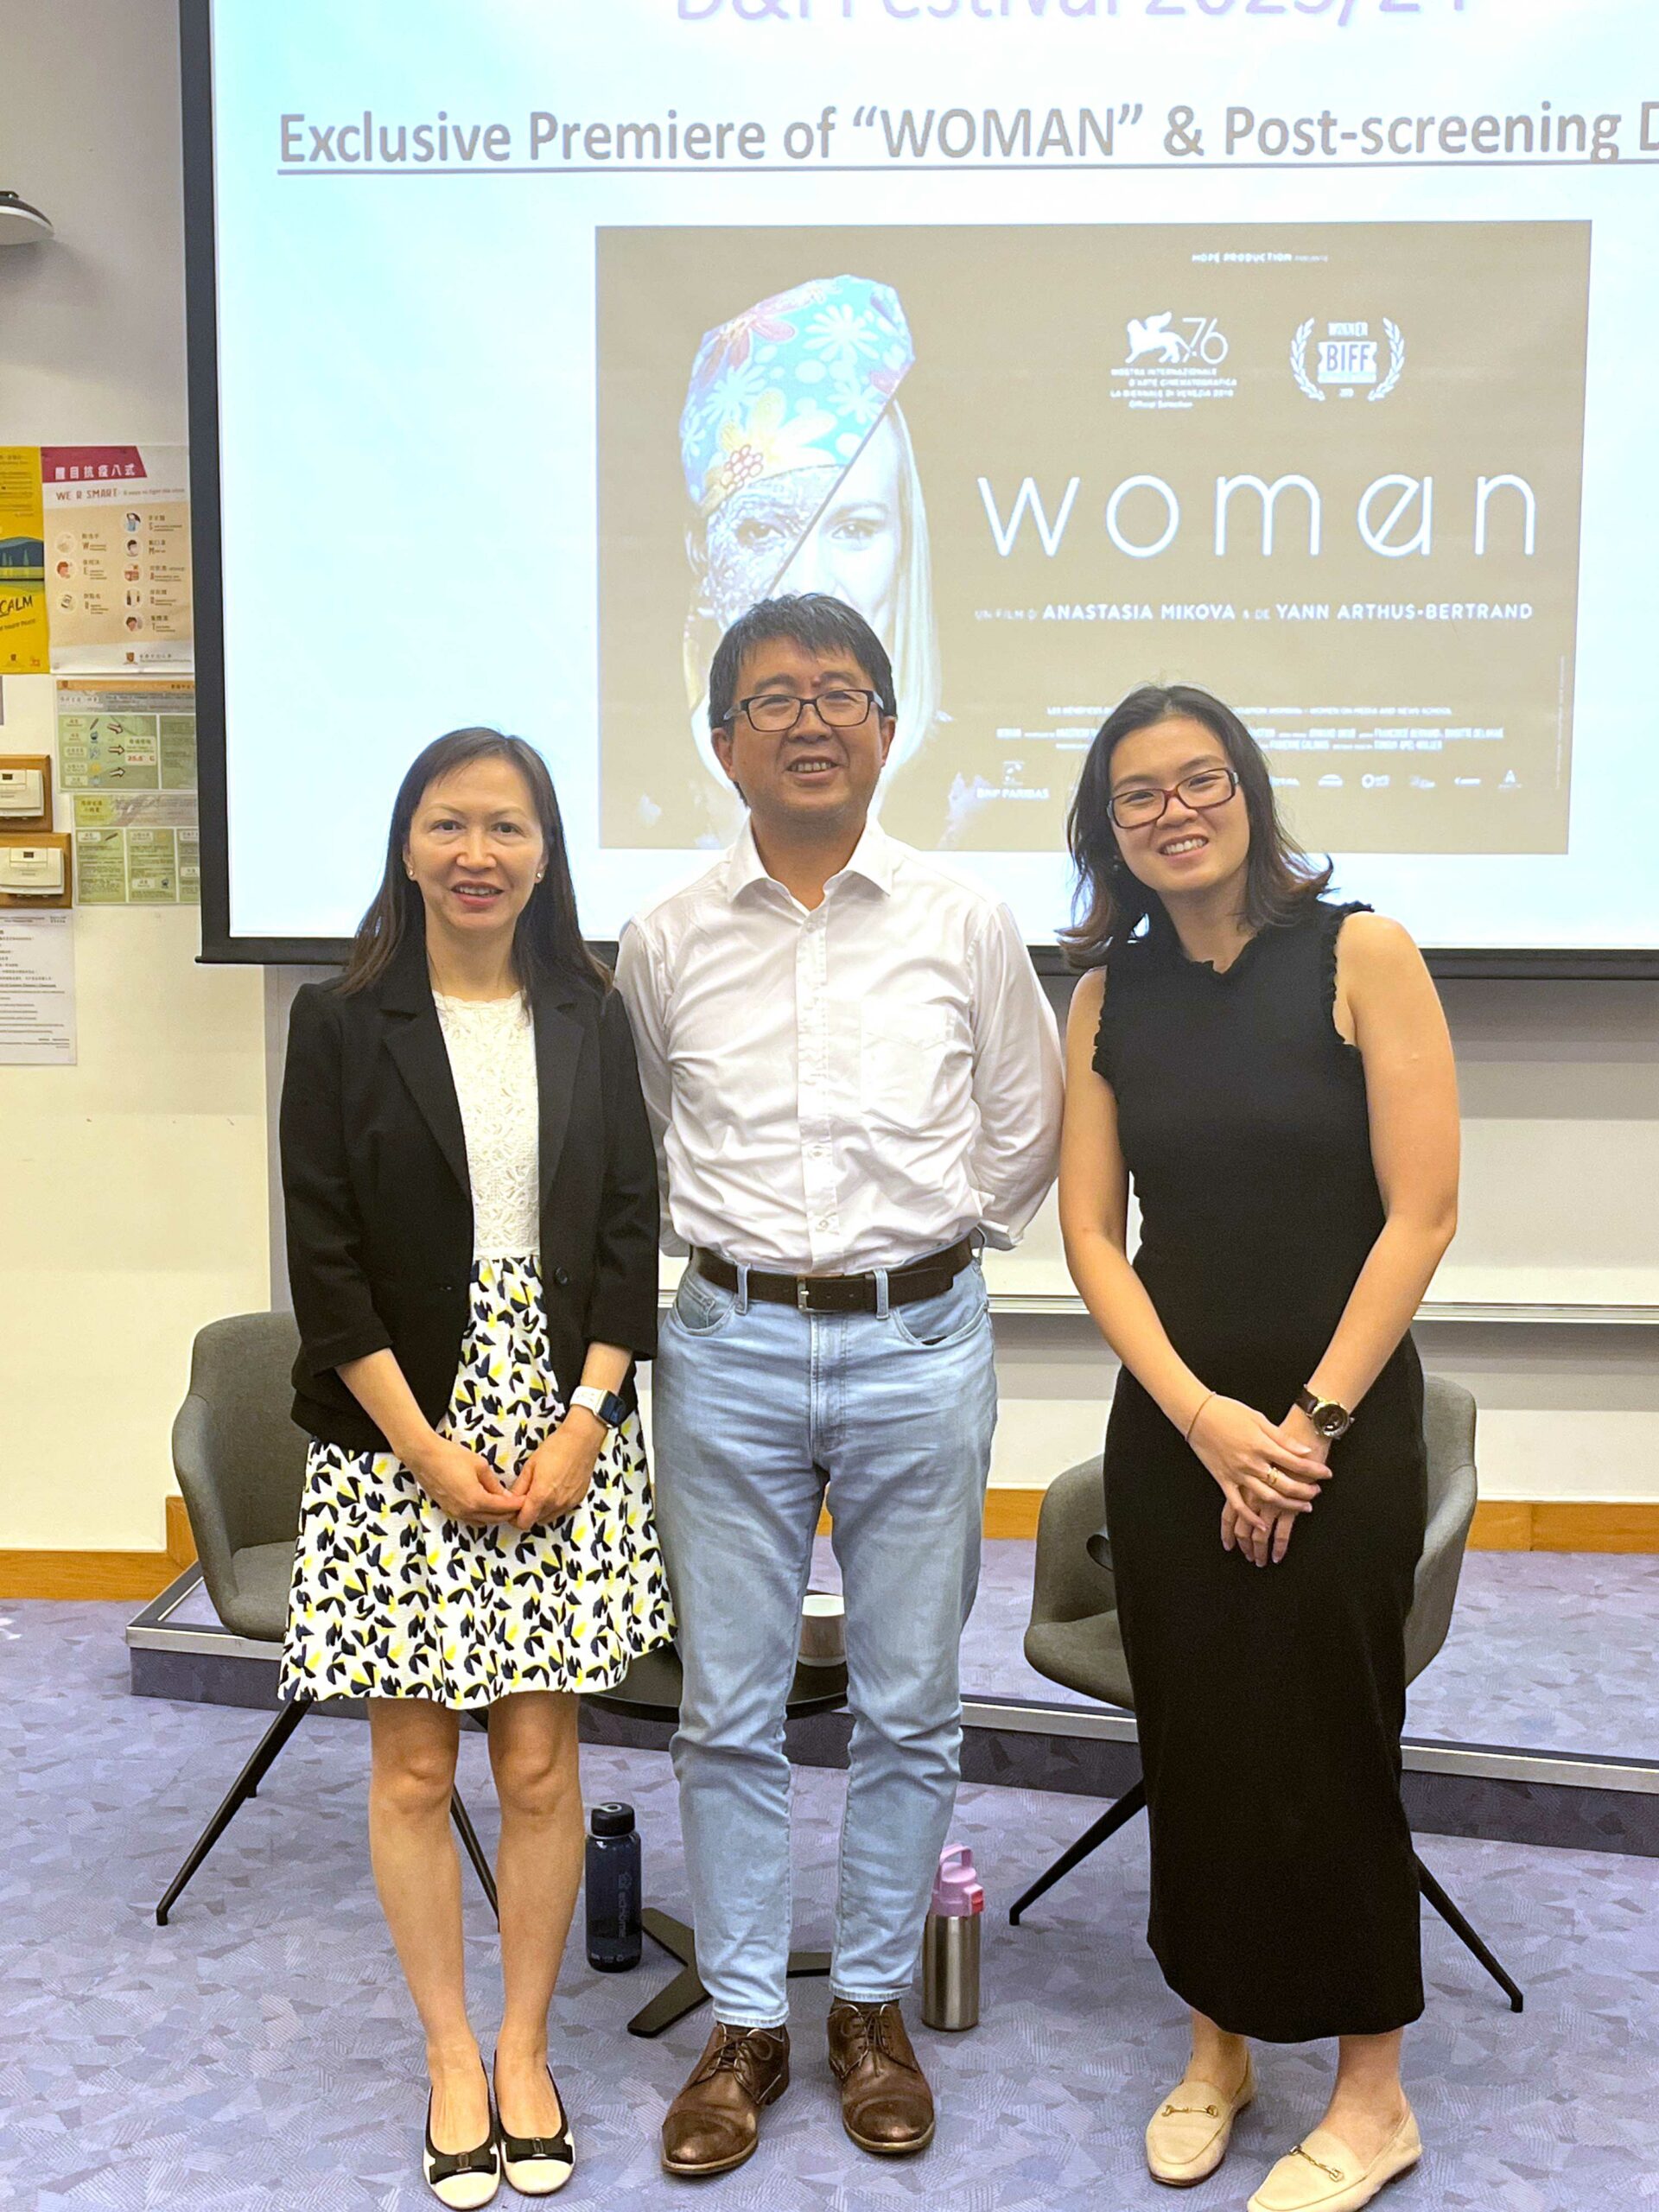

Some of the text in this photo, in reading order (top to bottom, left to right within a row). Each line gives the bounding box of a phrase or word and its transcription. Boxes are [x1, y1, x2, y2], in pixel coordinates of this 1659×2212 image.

[281, 111, 512, 162] Exclusive
[530, 109, 766, 161] Premiere
[783, 105, 836, 160] of
[1163, 105, 1204, 157] &
[1225, 100, 1622, 163] Post-screening
[1223, 251, 1293, 263] PRODUCTION
[1181, 317, 1229, 365] 76
[1326, 344, 1370, 372] BIFF
[56, 491, 71, 501] WE
[86, 488, 118, 499] SMART
[976, 474, 1536, 558] woman
[995, 608, 1024, 620] FILM
[1042, 603, 1154, 620] ANASTASIA
[1160, 603, 1236, 620] MIKOVA
[1275, 603, 1330, 620] YANN
[1001, 787, 1049, 799] PARIBAS
